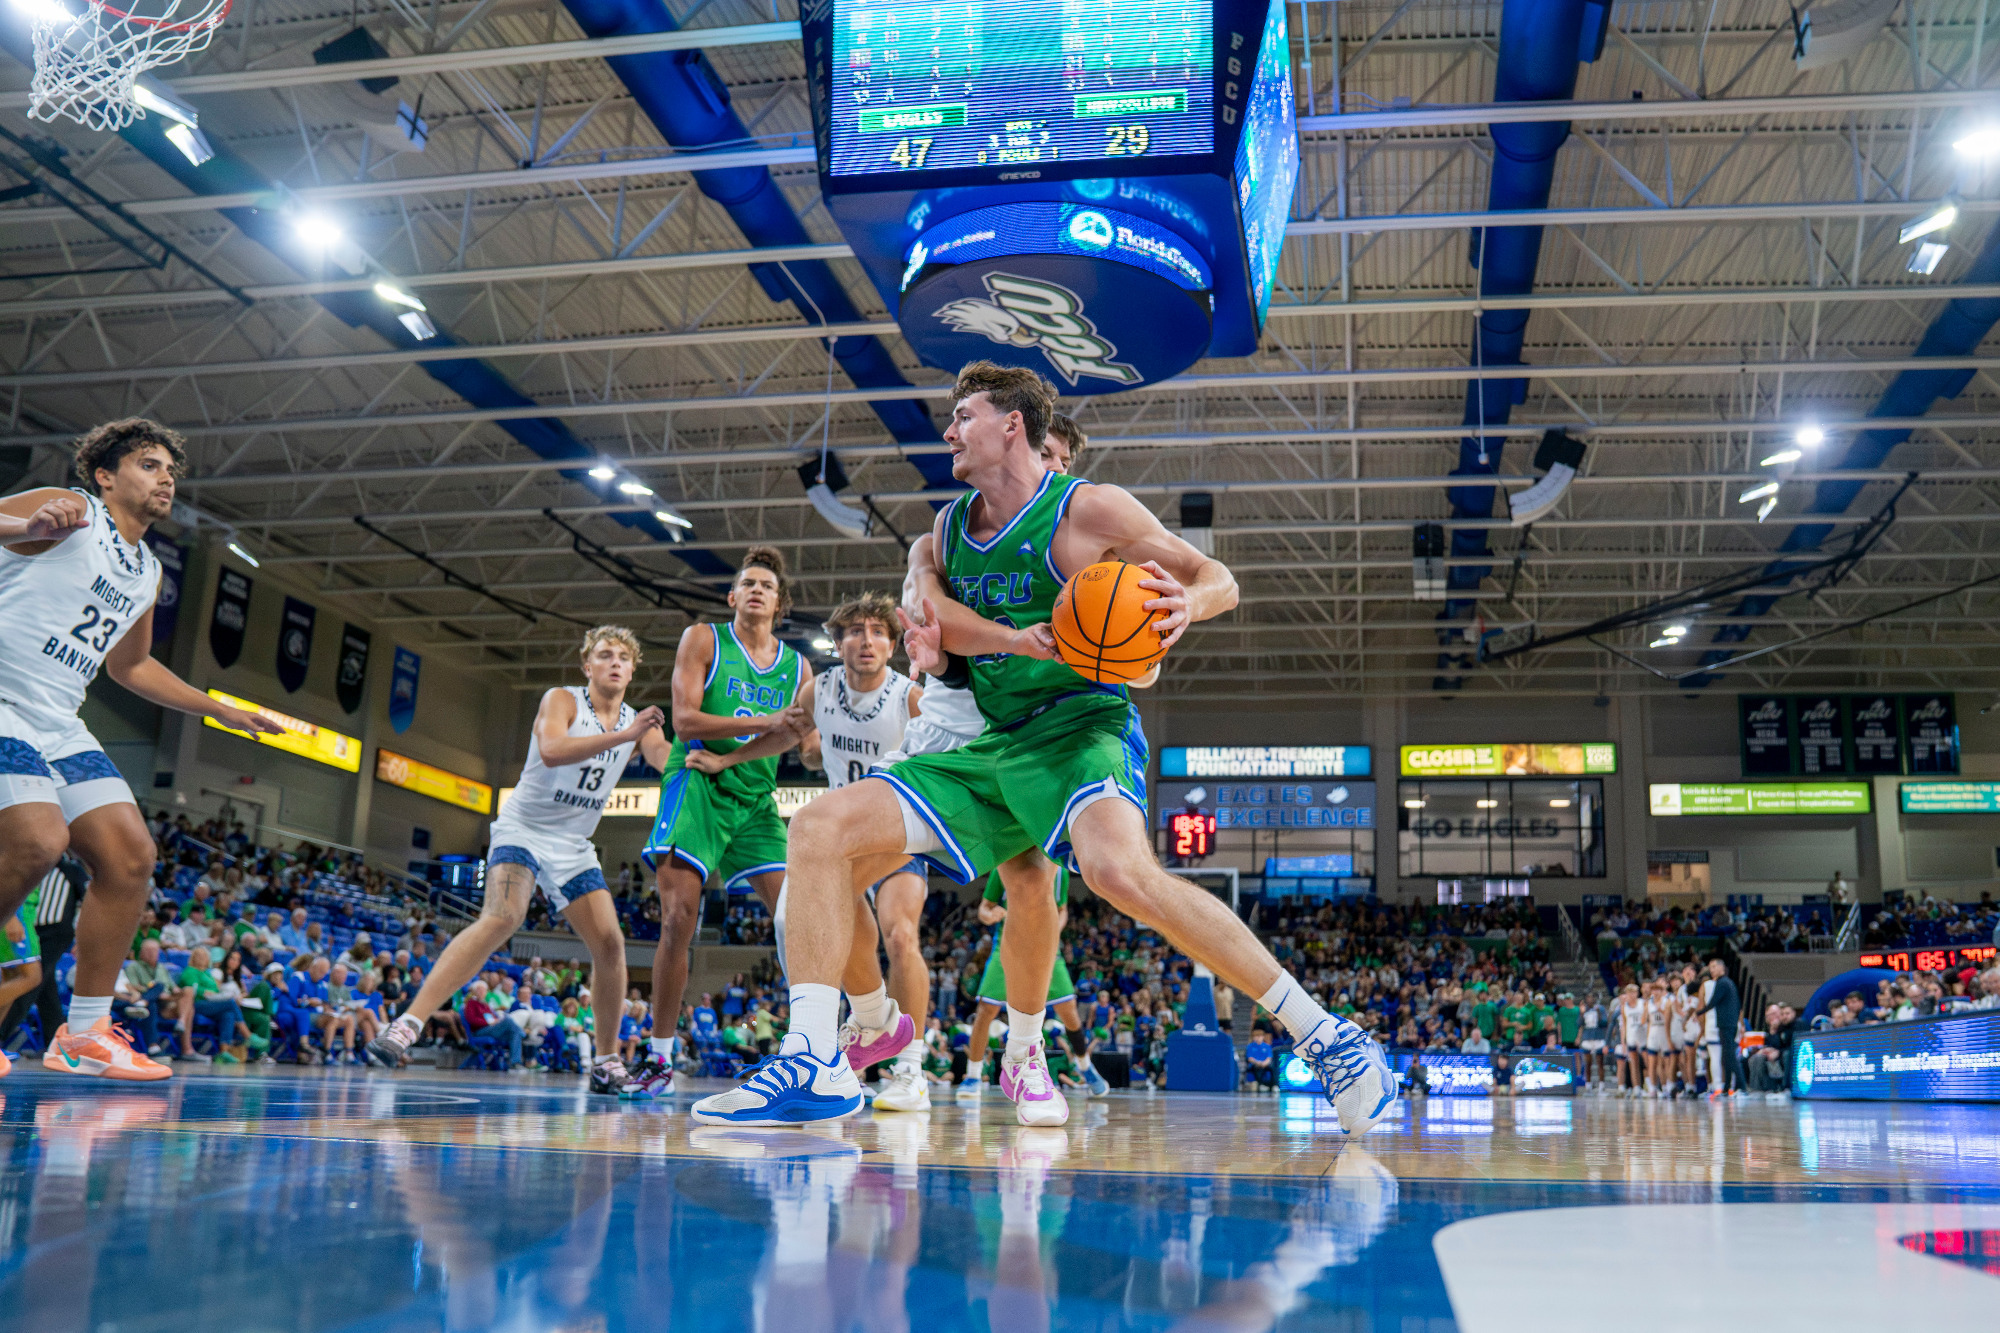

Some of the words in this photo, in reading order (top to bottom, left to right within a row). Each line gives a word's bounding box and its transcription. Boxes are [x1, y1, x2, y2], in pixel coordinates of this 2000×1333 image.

[1222, 31, 1244, 125] FGCU
[1105, 125, 1149, 155] 29
[889, 138, 934, 169] 47
[90, 574, 136, 618] MIGHTY
[70, 604, 118, 653] 23
[41, 635, 99, 681] BANYAN
[727, 675, 785, 710] FGCU
[831, 733, 880, 756] MIGHTY
[1187, 760, 1291, 775] FOUNDATION
[1294, 760, 1345, 775] SUITE
[1408, 748, 1476, 768] CLOSER
[577, 765, 606, 792] 13
[553, 789, 603, 812] BANYANS
[1216, 785, 1313, 806] EAGLES
[1174, 815, 1216, 834] 18:51
[1215, 807, 1372, 827] EXCELLENCE
[1412, 817, 1452, 838] GO
[1459, 817, 1559, 839] EAGLES
[1176, 832, 1206, 855] 21
[1887, 952, 1909, 971] 47
